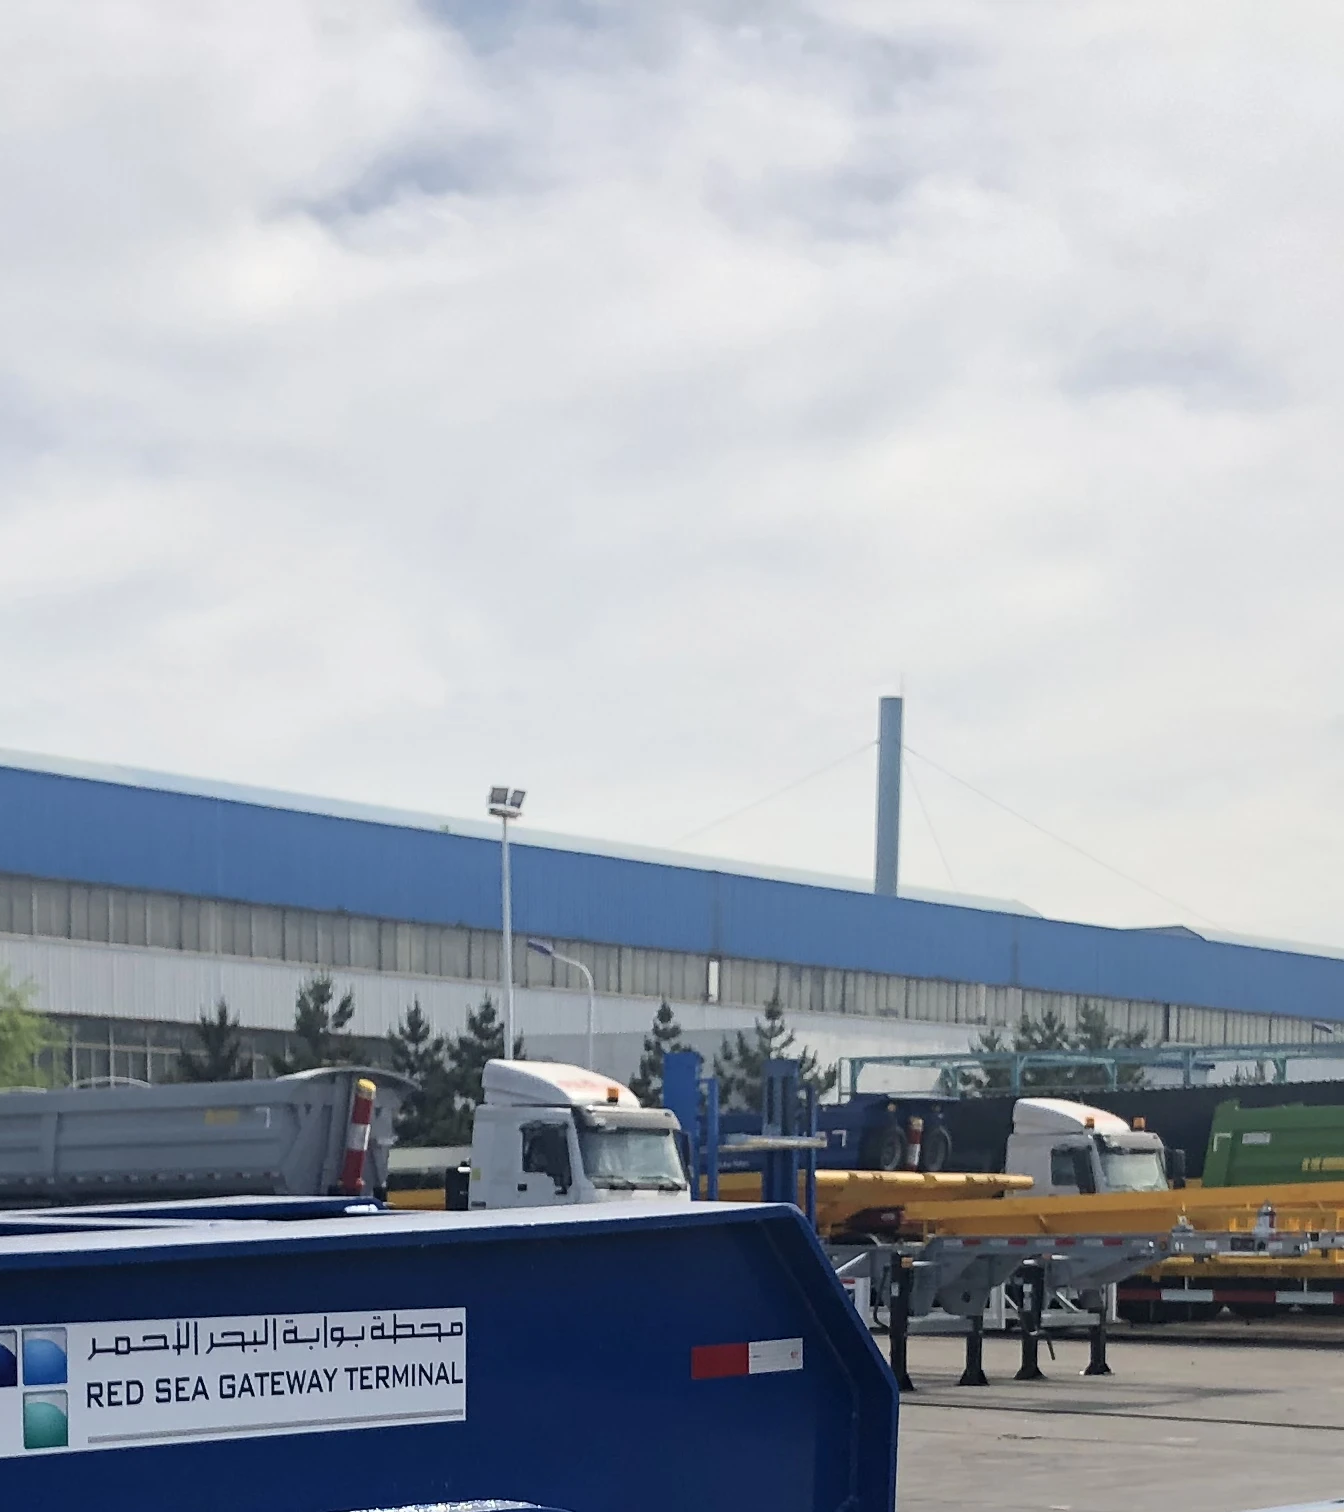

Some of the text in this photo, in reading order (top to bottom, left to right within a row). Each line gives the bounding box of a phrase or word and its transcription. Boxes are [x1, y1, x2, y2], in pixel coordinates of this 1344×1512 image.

[206, 1317, 277, 1355] البحر
[282, 1315, 365, 1351] بوابة
[370, 1313, 463, 1345] محطة
[86, 1361, 464, 1409] RED SEA GATEWAY TERMINAL
